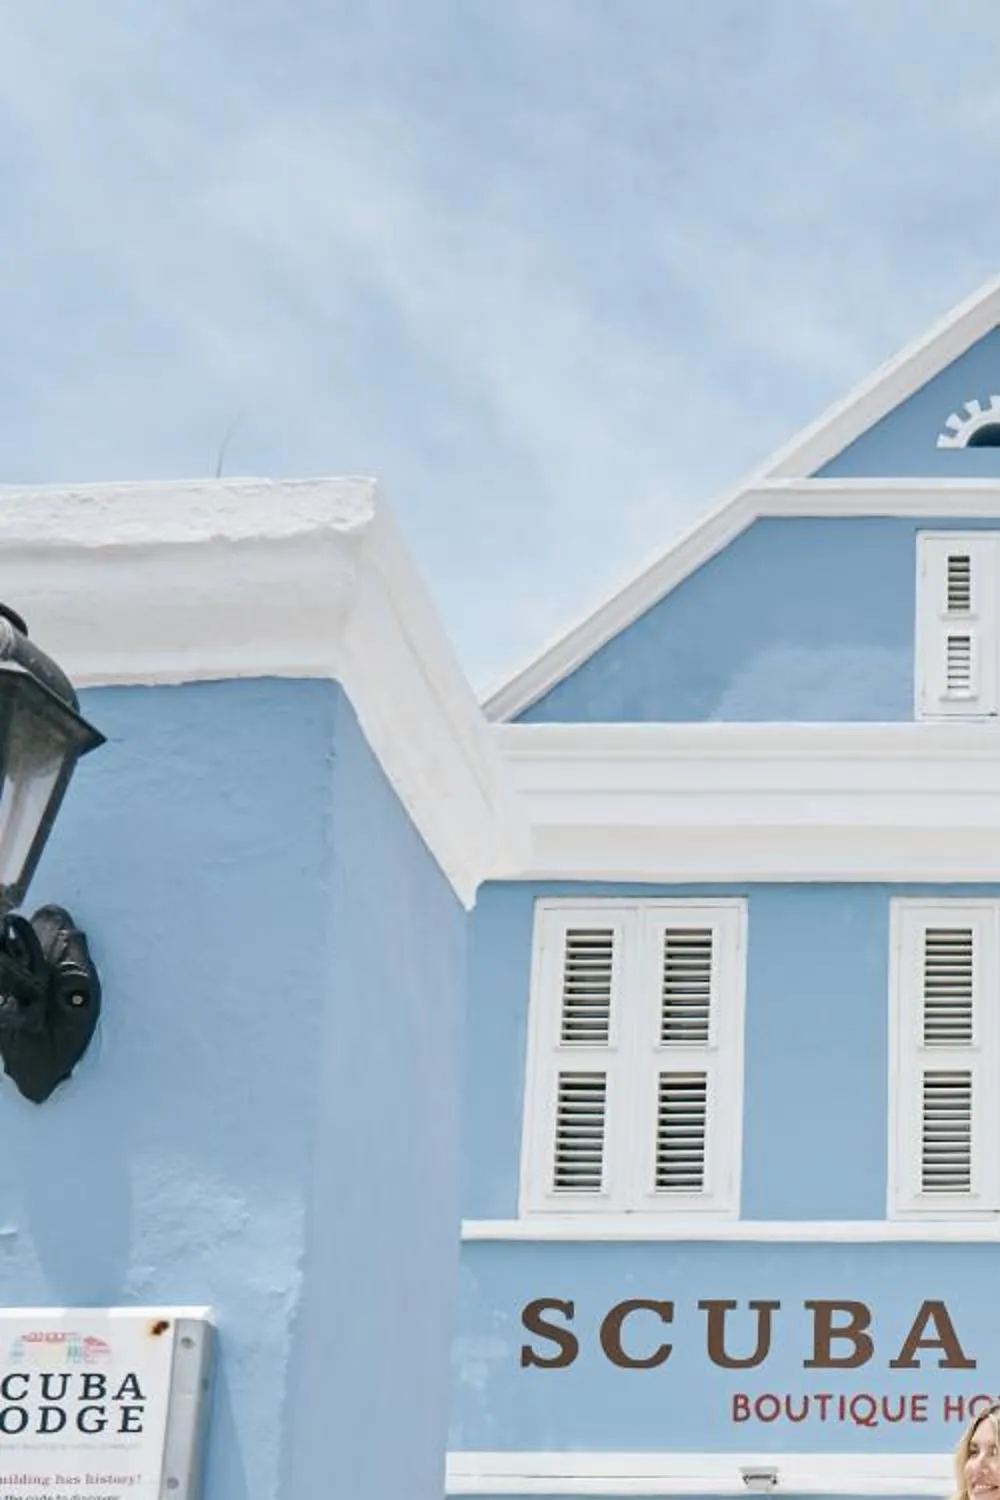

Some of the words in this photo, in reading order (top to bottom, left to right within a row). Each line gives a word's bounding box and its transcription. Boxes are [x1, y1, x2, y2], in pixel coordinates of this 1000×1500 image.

[519, 1298, 977, 1370] SCUBA
[0, 1372, 147, 1401] CUBA
[0, 1405, 145, 1434] ODGE
[732, 1394, 929, 1426] BOUTIQUE
[55, 1473, 81, 1485] has
